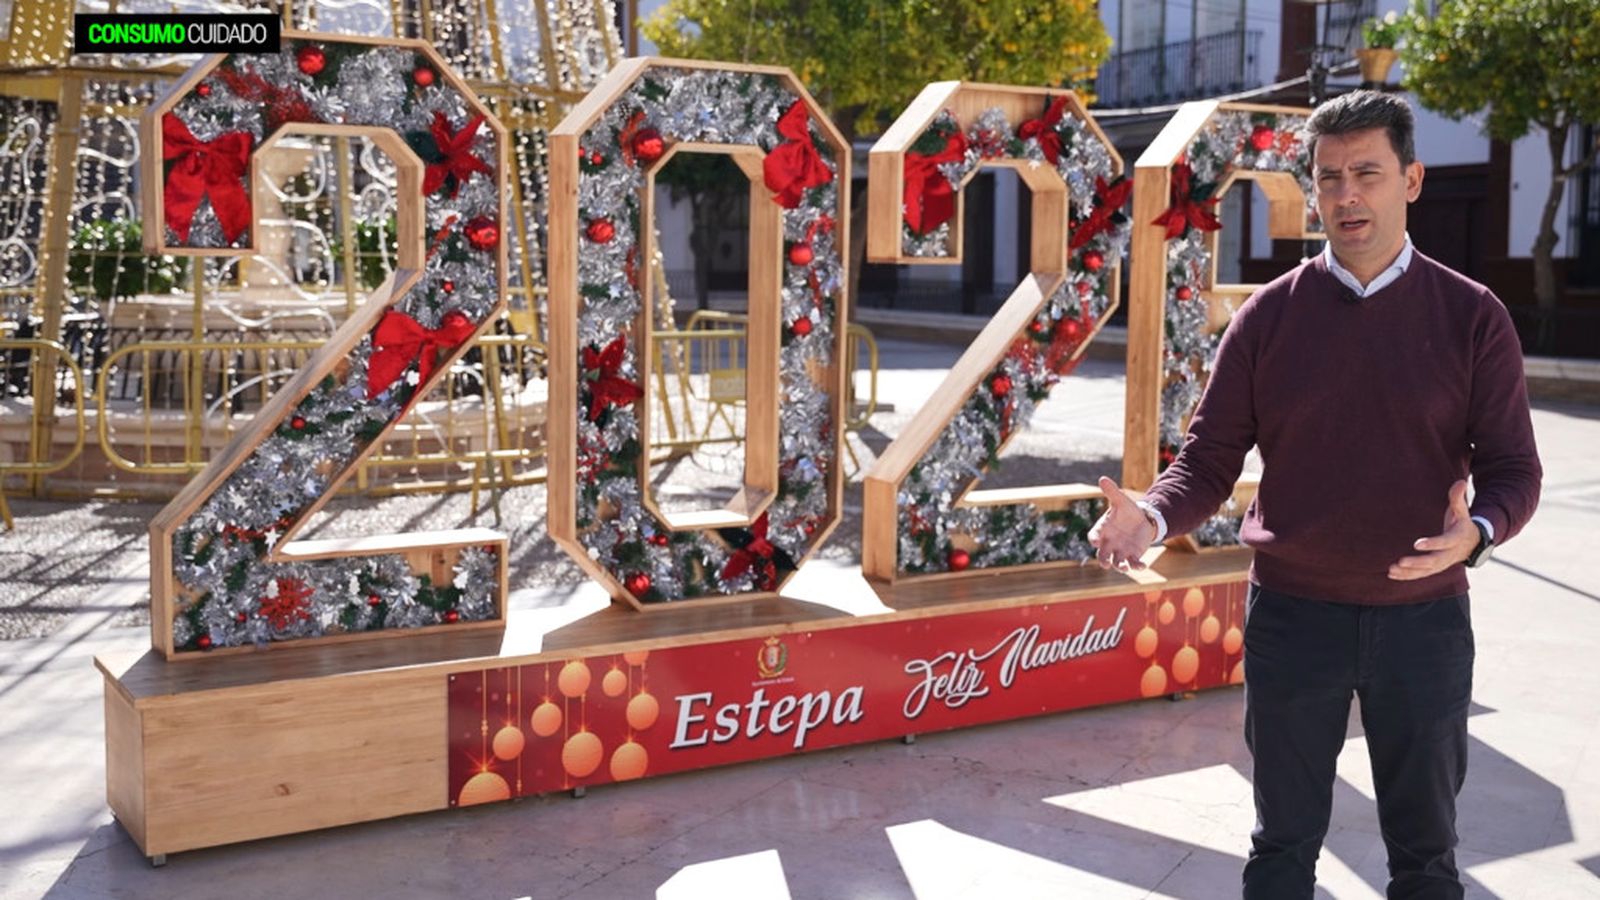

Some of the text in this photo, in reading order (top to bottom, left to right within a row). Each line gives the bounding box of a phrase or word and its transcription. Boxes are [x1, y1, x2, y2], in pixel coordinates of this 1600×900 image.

[903, 607, 1127, 720] Feliz Navidad
[669, 686, 865, 751] Estepa
